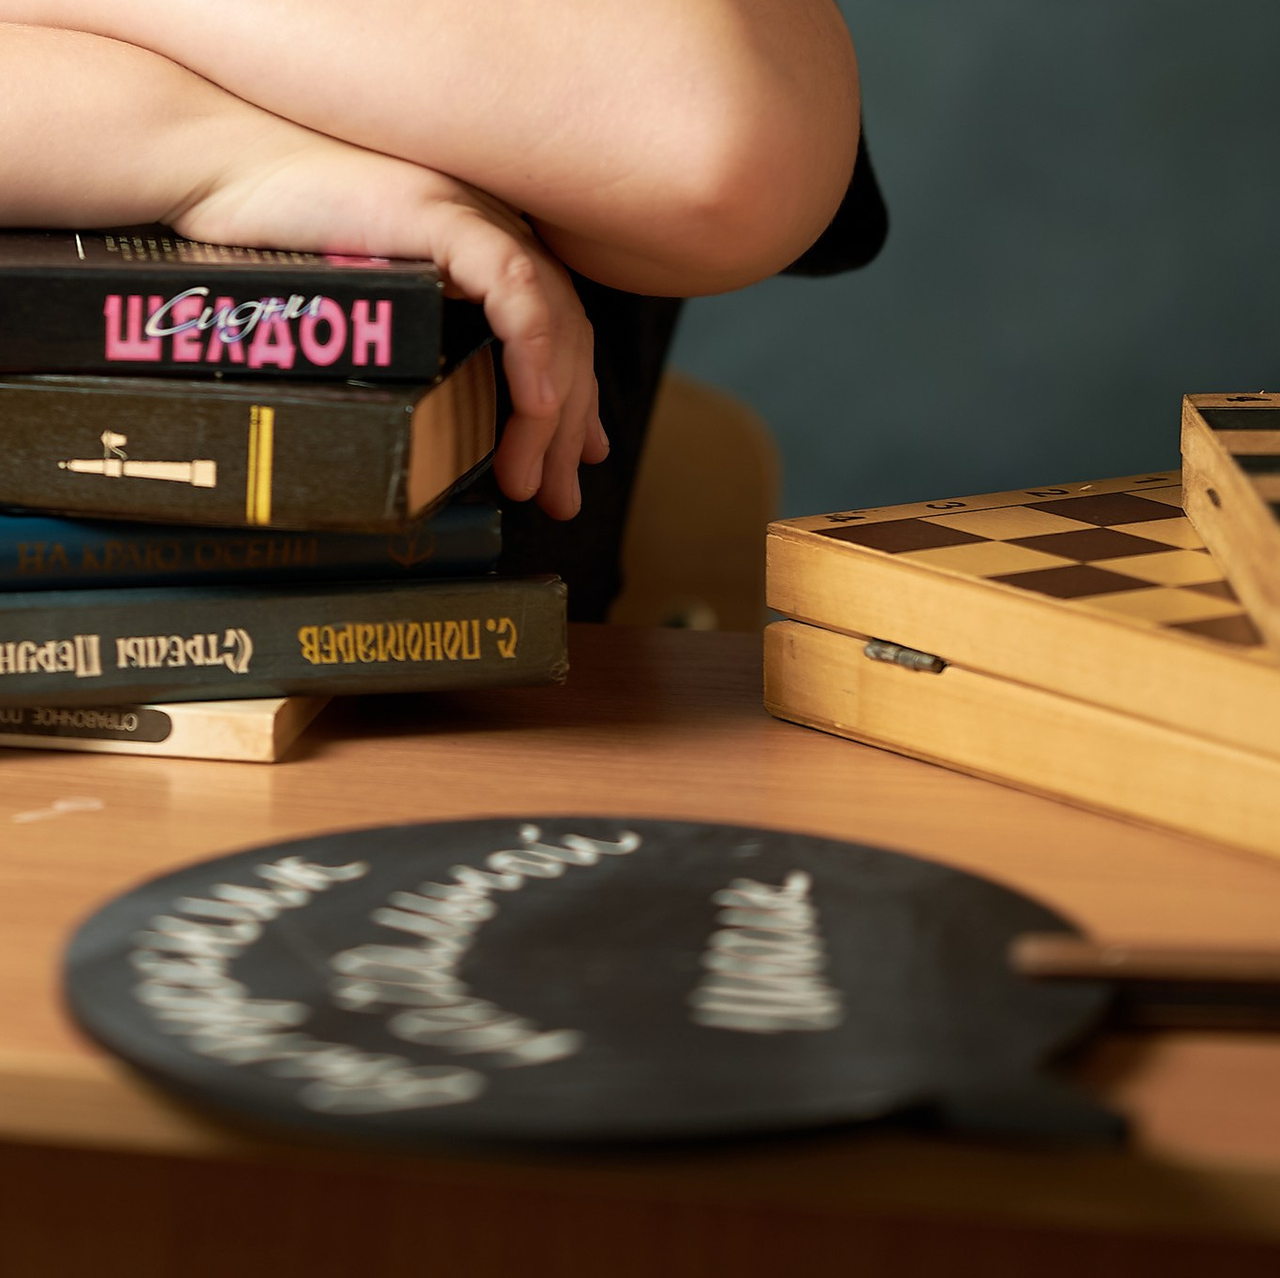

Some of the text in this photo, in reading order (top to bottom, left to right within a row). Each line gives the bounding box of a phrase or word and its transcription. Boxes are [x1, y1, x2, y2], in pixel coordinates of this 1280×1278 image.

[103, 294, 393, 369] ШЕЛДОН
[145, 287, 323, 343] Сидни
[926, 501, 967, 511] 3
[1024, 488, 1070, 498] 2
[16, 536, 319, 574] НА КРАЮ ОСЕНИ
